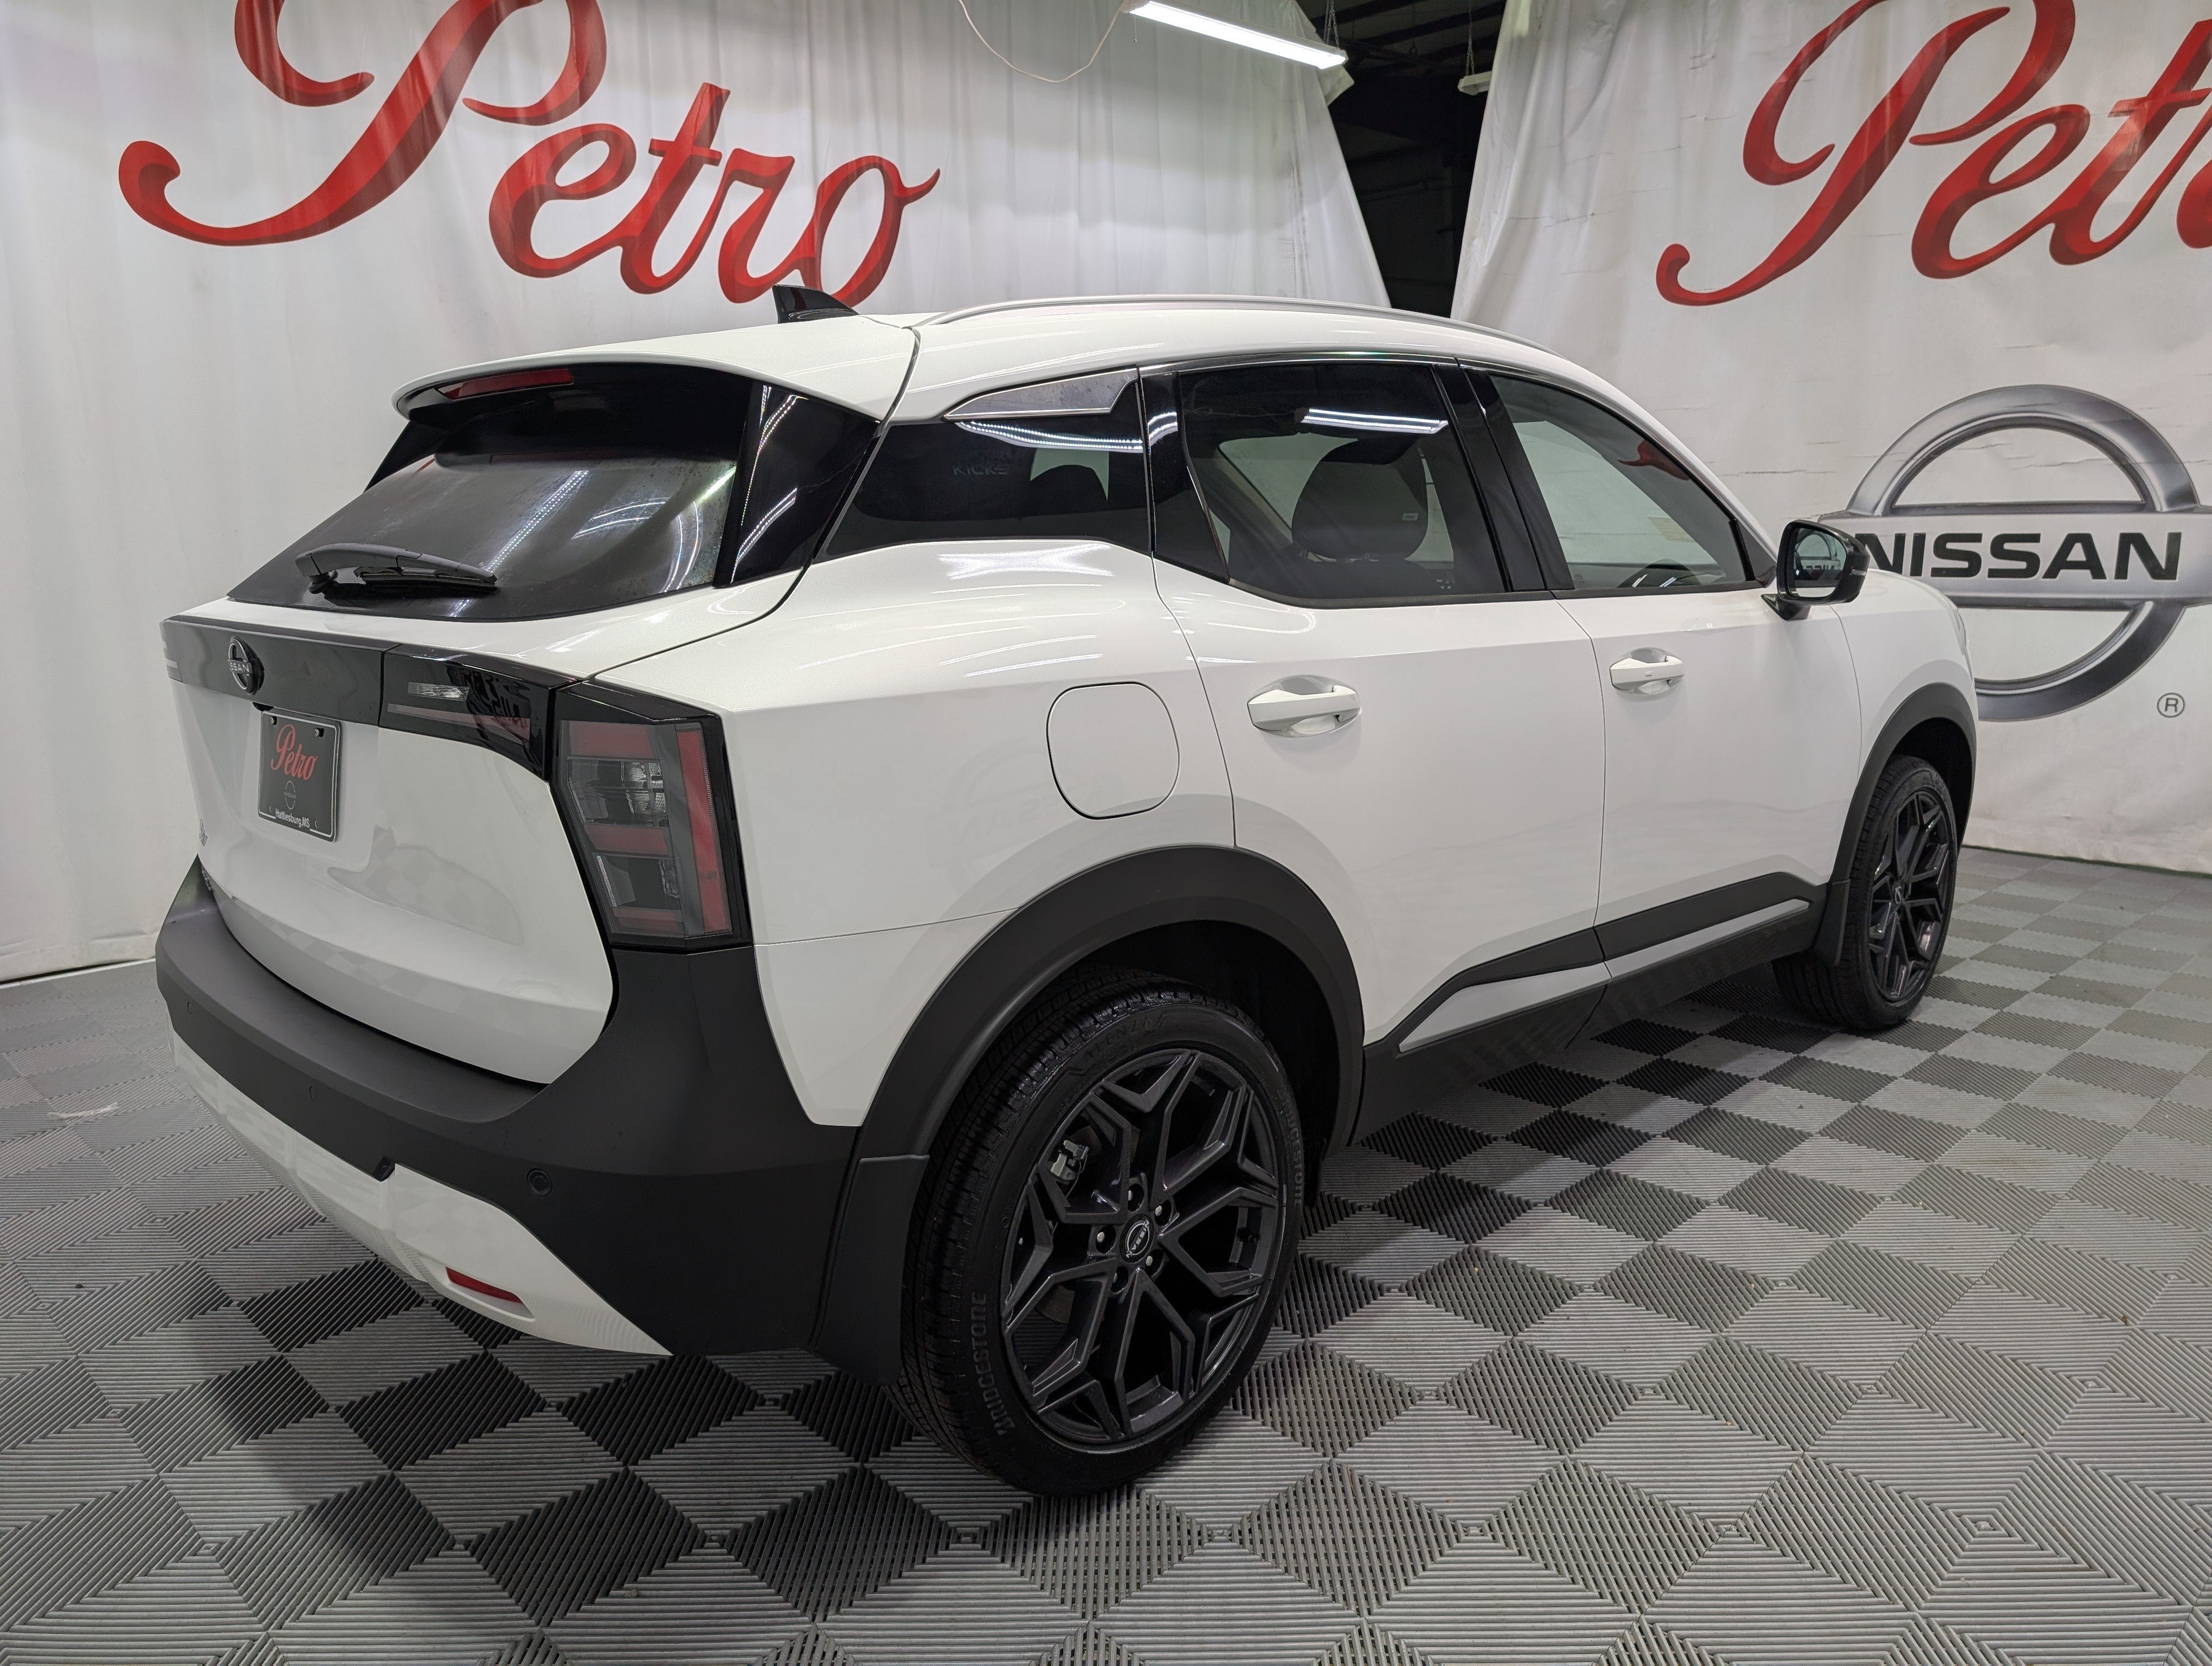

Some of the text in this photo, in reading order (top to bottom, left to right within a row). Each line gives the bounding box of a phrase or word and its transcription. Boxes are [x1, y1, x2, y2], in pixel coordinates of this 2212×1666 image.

[118, 0, 940, 304] Petro
[271, 724, 318, 780] Petro
[1126, 1220, 1149, 1258] NISSAN
[971, 1291, 1015, 1436] BRIDGESTONE
